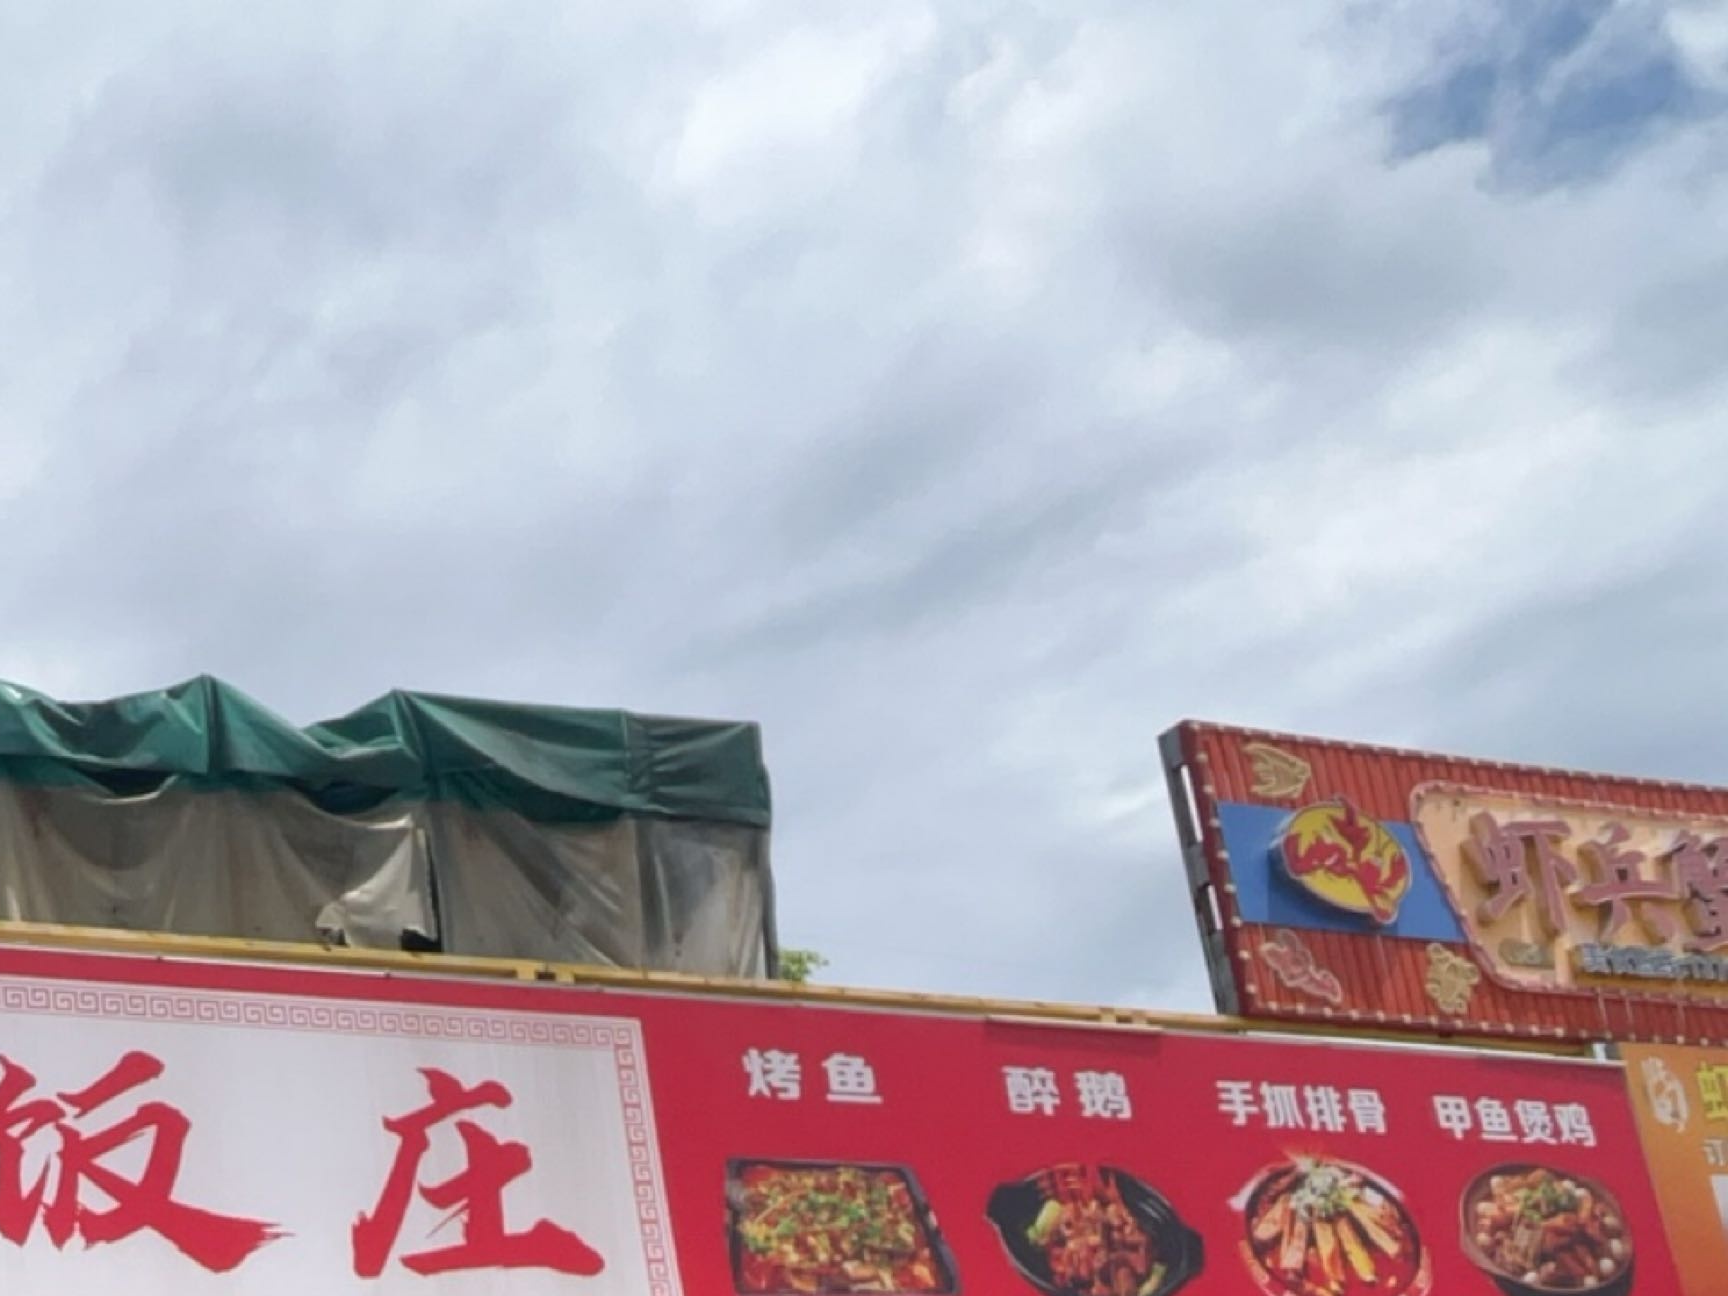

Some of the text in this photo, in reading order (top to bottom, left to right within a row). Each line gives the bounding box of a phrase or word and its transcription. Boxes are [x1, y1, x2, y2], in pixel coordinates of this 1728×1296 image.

[742, 1047, 883, 1104] 烤鱼
[1002, 1066, 1133, 1119] 醉鹅
[1216, 1080, 1387, 1134] 手抓排骨
[1432, 1095, 1597, 1146] 甲鱼煲鸡
